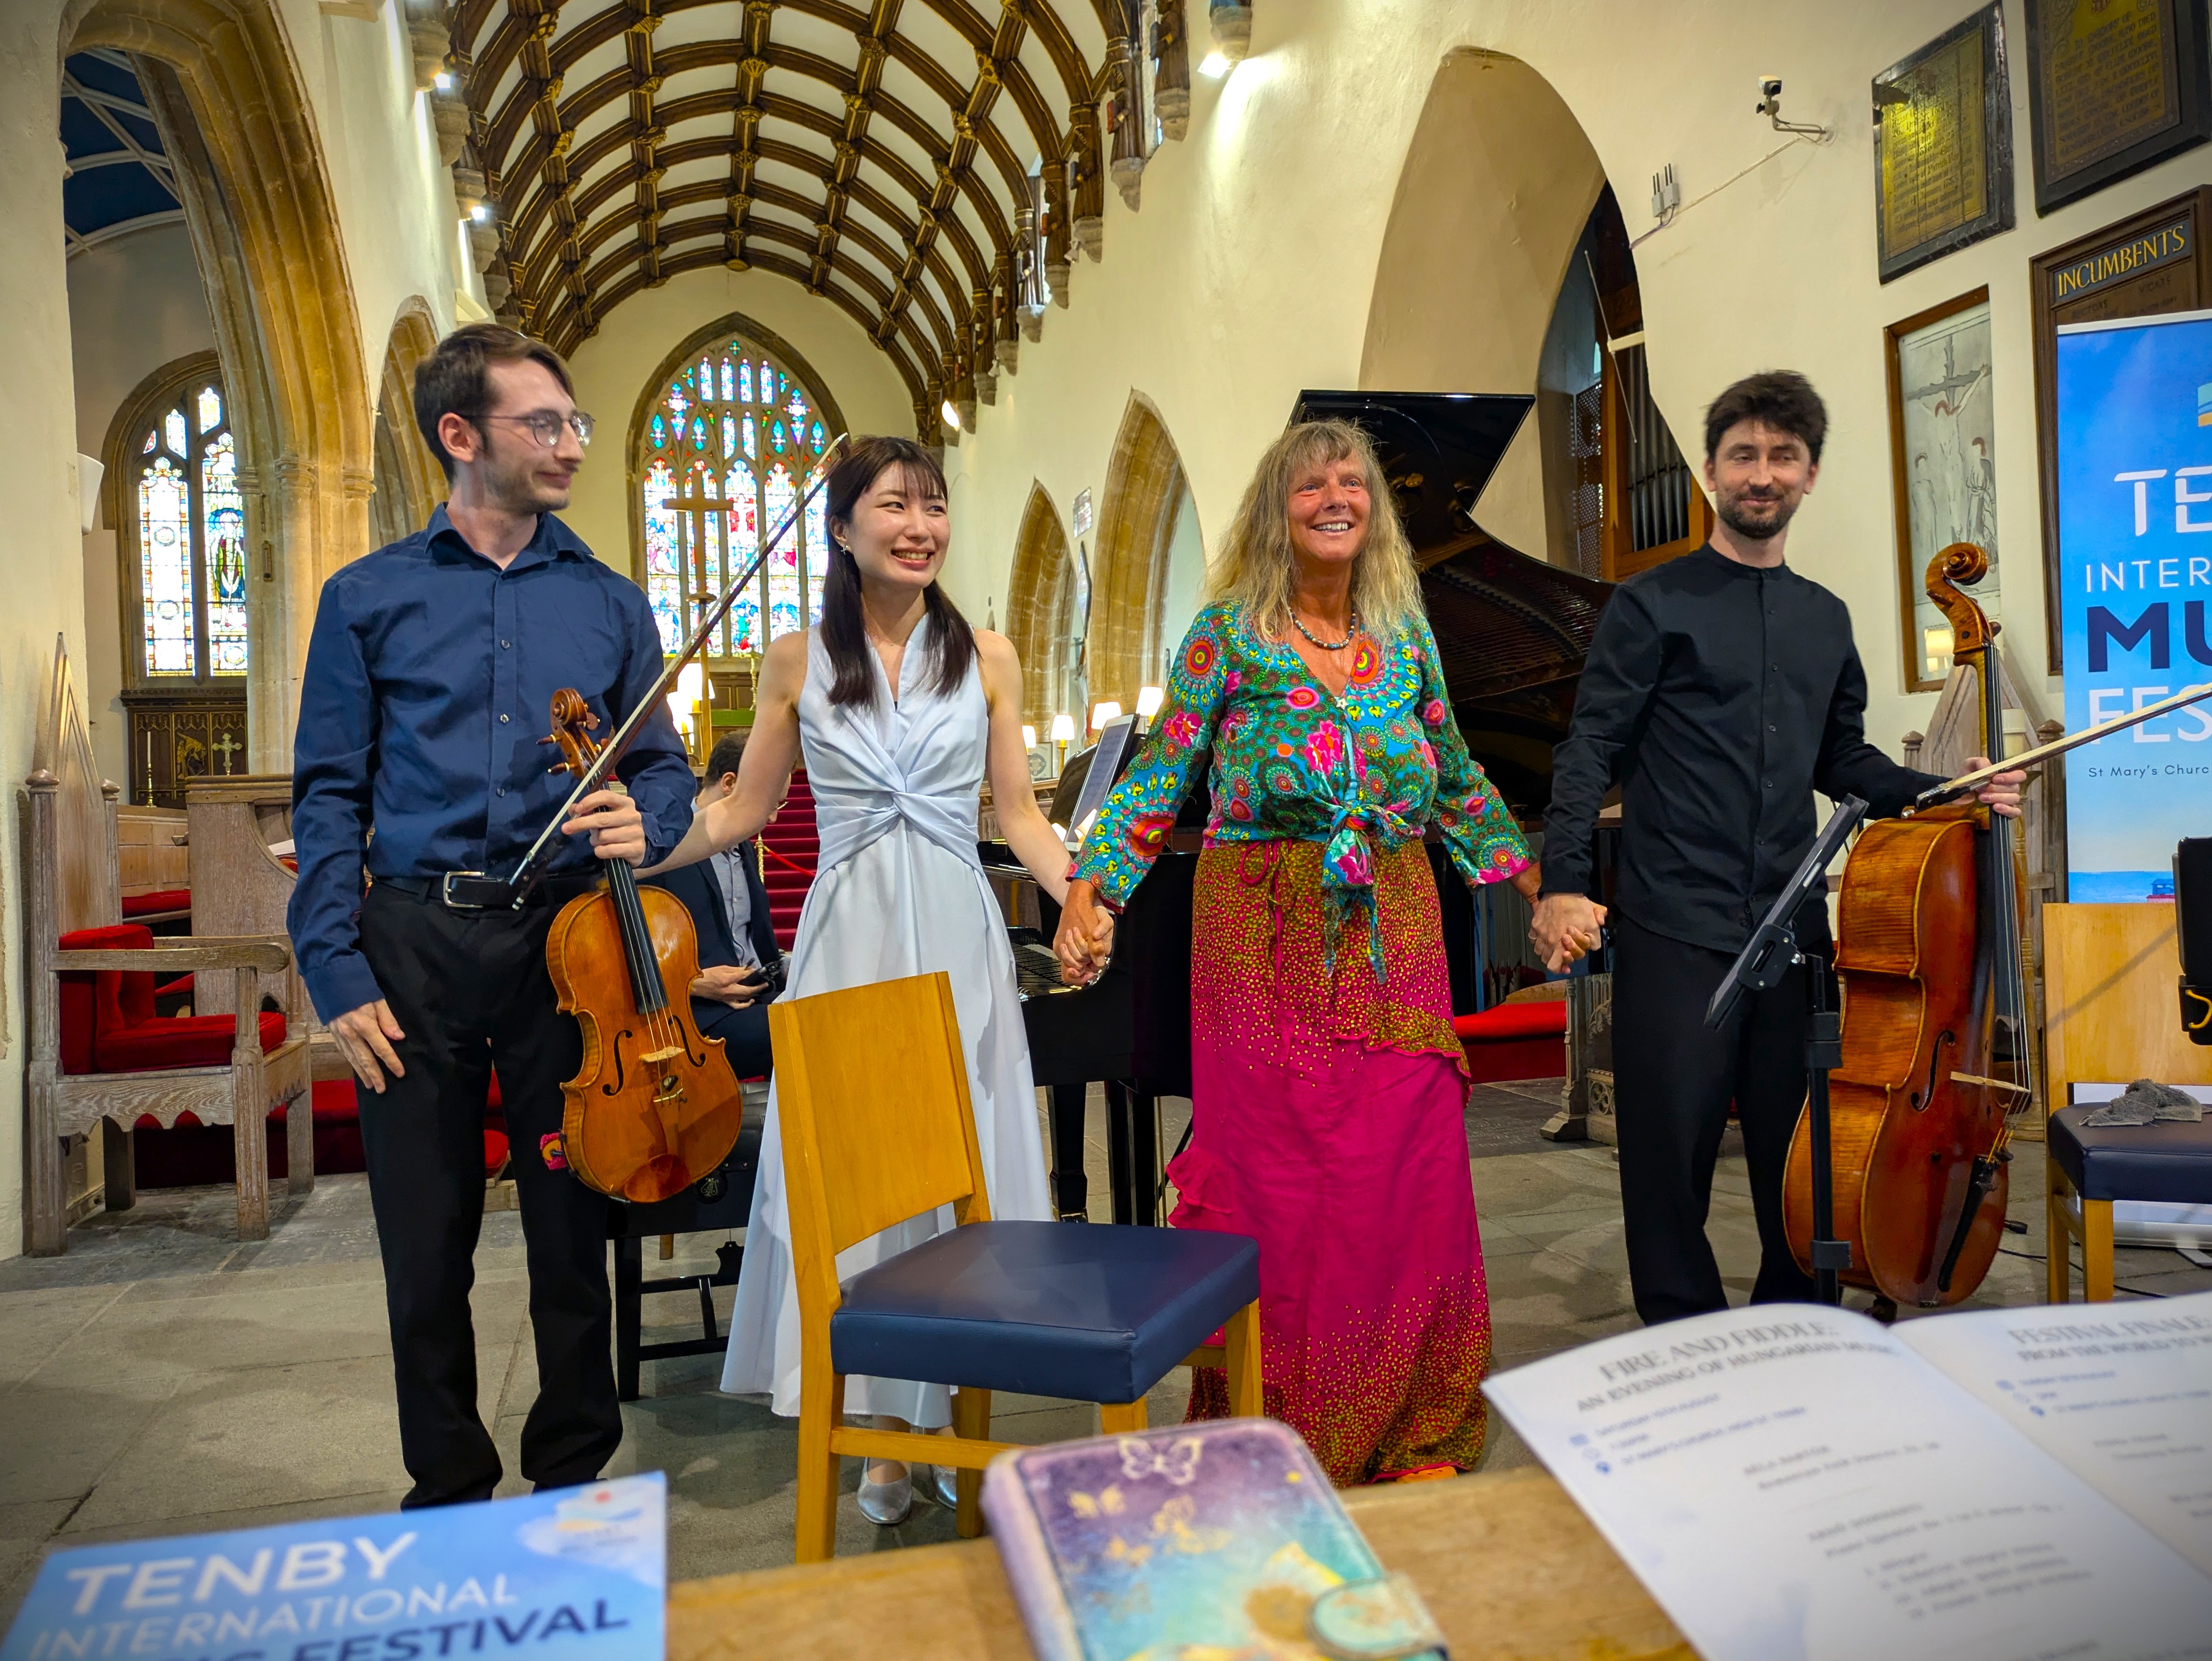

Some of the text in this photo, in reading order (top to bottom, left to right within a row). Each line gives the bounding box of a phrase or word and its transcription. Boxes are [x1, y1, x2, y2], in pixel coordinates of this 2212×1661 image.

[2058, 225, 2185, 297] INCUMBENTS
[2086, 557, 2211, 593] INTER
[2088, 763, 2212, 779] St Mary's Churc
[1599, 1349, 1663, 1381] FIRE
[1669, 1335, 1728, 1362] AND
[1608, 1366, 1696, 1401] EVENING
[67, 1532, 417, 1615] TENBY
[28, 1574, 518, 1661] INTERNATIONAL
[293, 1599, 629, 1661] FESTIVAL
